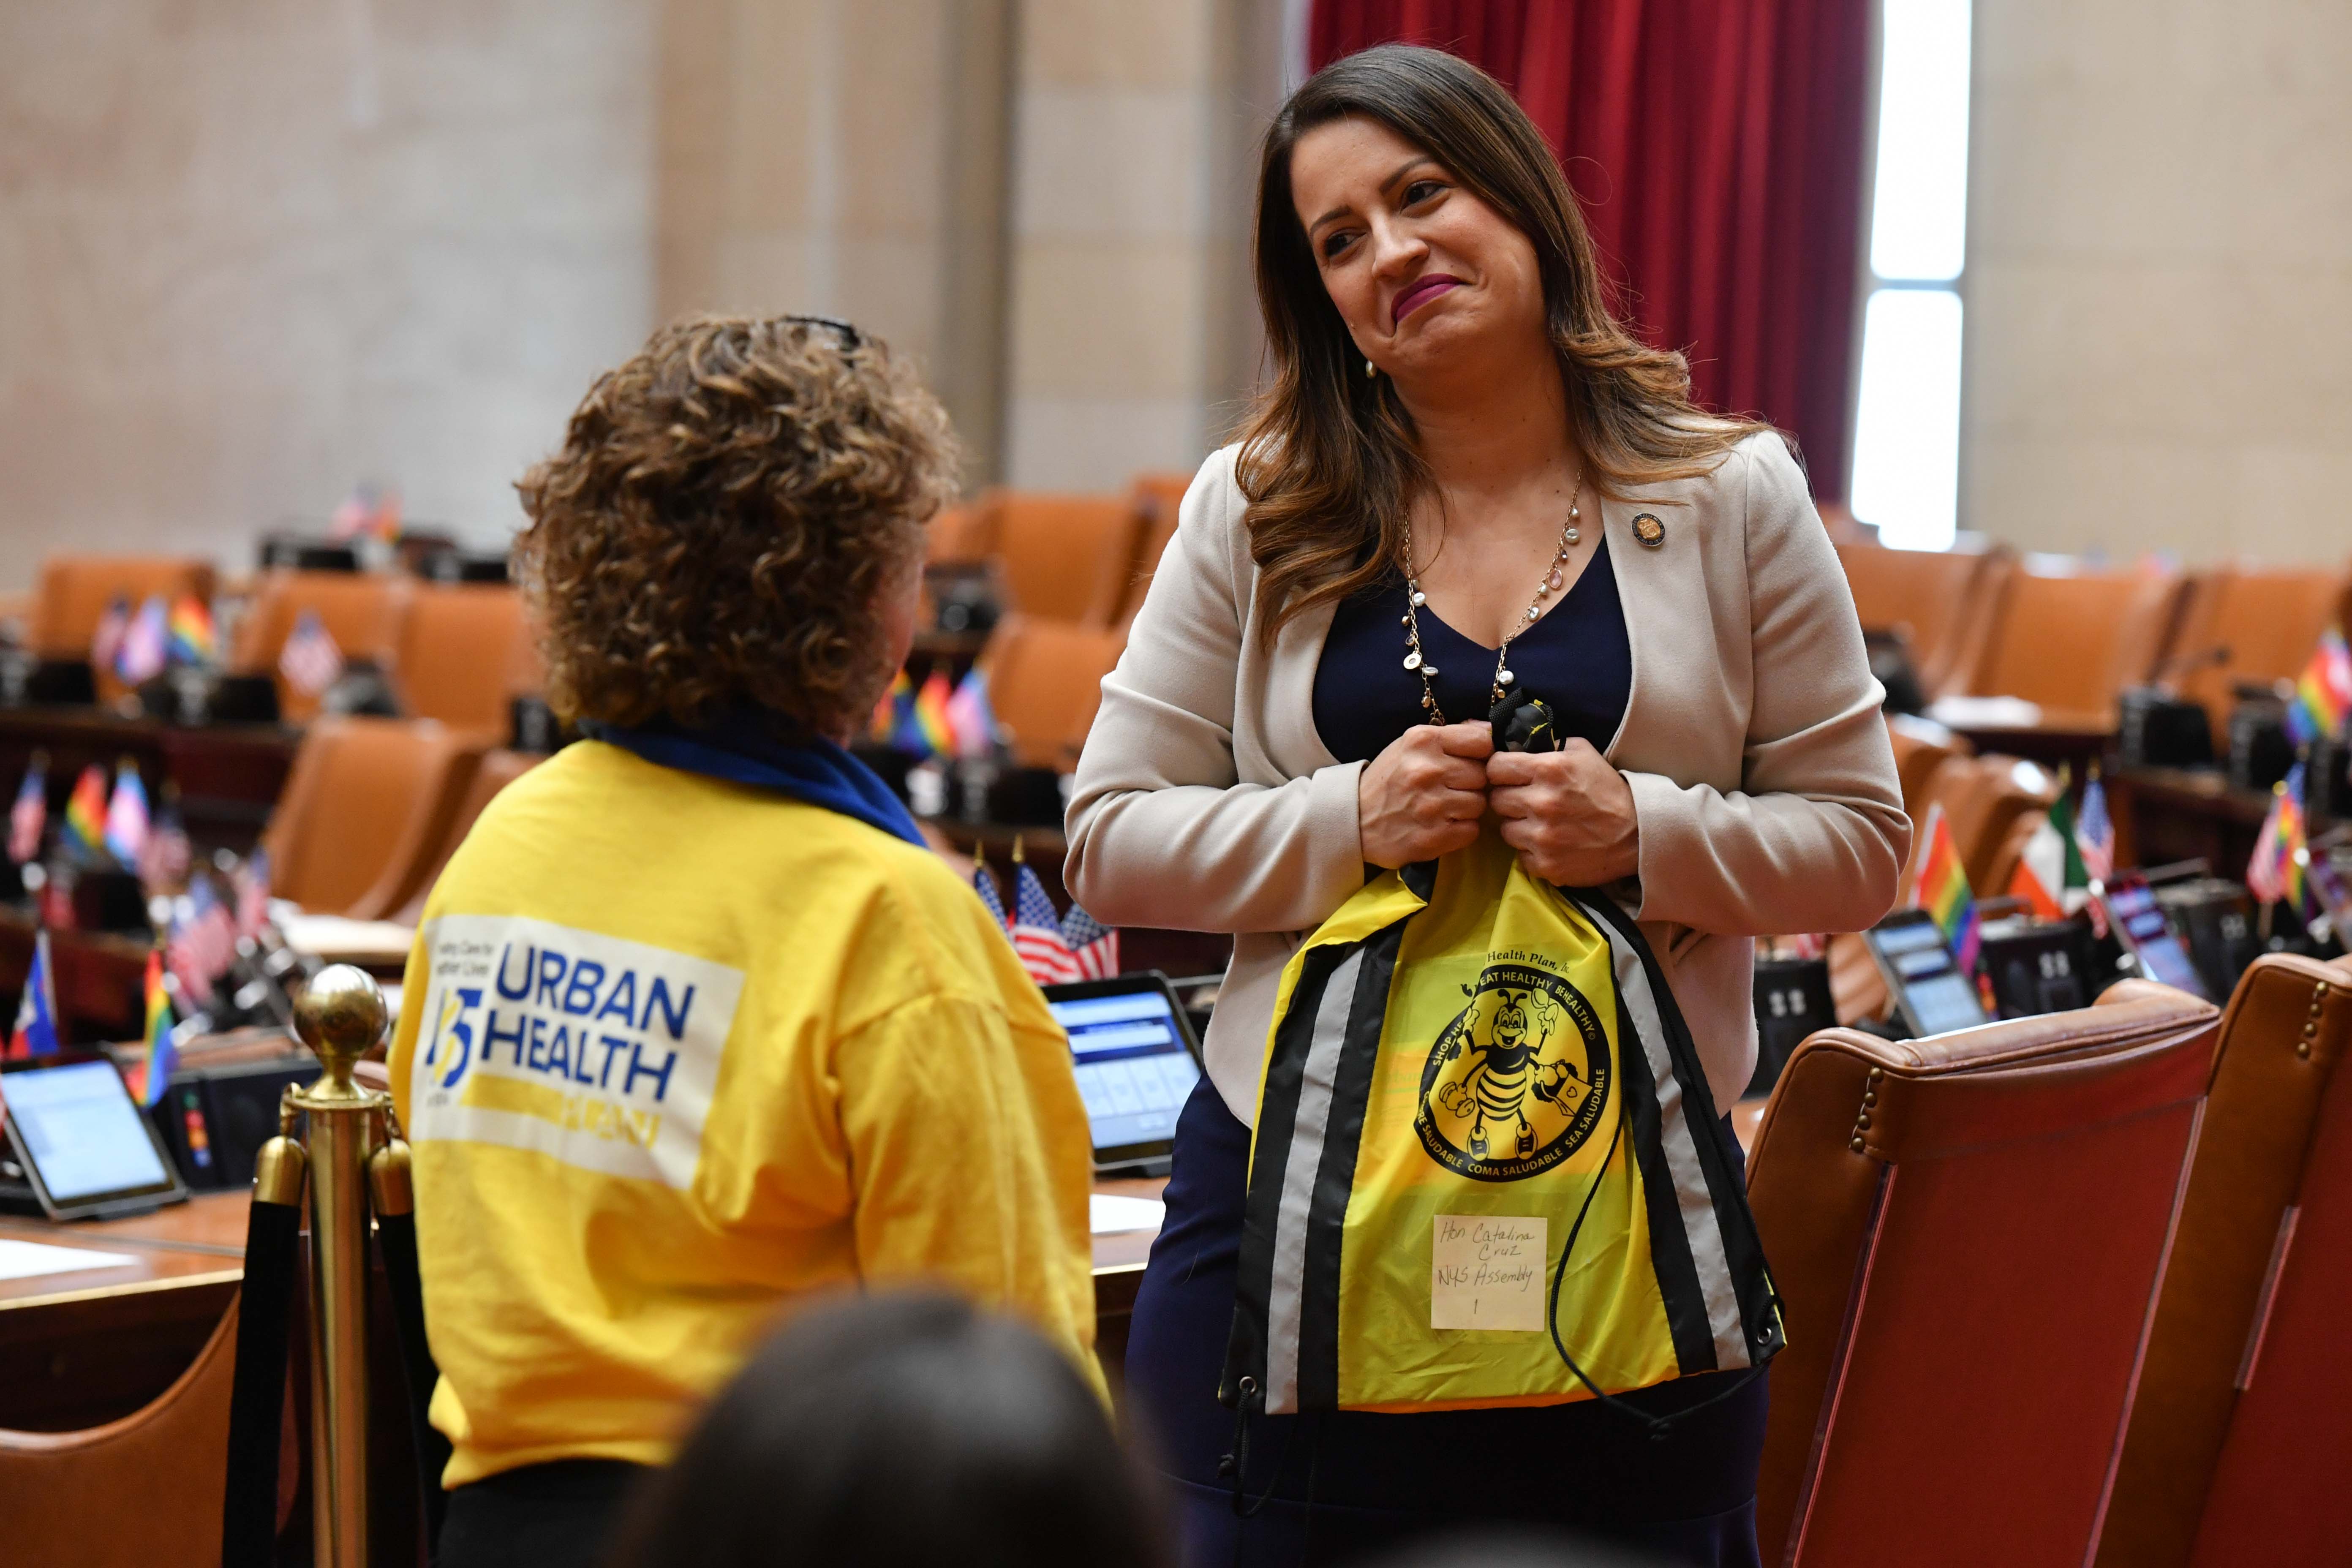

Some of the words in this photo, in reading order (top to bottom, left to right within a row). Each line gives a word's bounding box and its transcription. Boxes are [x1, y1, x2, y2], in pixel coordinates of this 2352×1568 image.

[1487, 950, 1525, 962] Health
[1529, 953, 1558, 971] Plan,
[496, 942, 695, 1041] URBAN
[1479, 972, 1499, 986] EAT
[1502, 972, 1553, 991] HEALTHY
[481, 1009, 678, 1102] HEALTH
[1433, 1036, 1452, 1066] SHOP
[1565, 1130, 1582, 1149] SEA
[1580, 1069, 1605, 1130] SALUDABLE
[1422, 1124, 1464, 1168] SALUDABLE
[1467, 1163, 1500, 1176] COMA
[1502, 1148, 1563, 1176] SALUDABLE
[1440, 1220, 1465, 1243] Hon
[1473, 1223, 1535, 1244] Catalina
[1478, 1243, 1522, 1261] Cruz
[1438, 1265, 1469, 1288] NYS
[1474, 1263, 1533, 1292] Assembly
